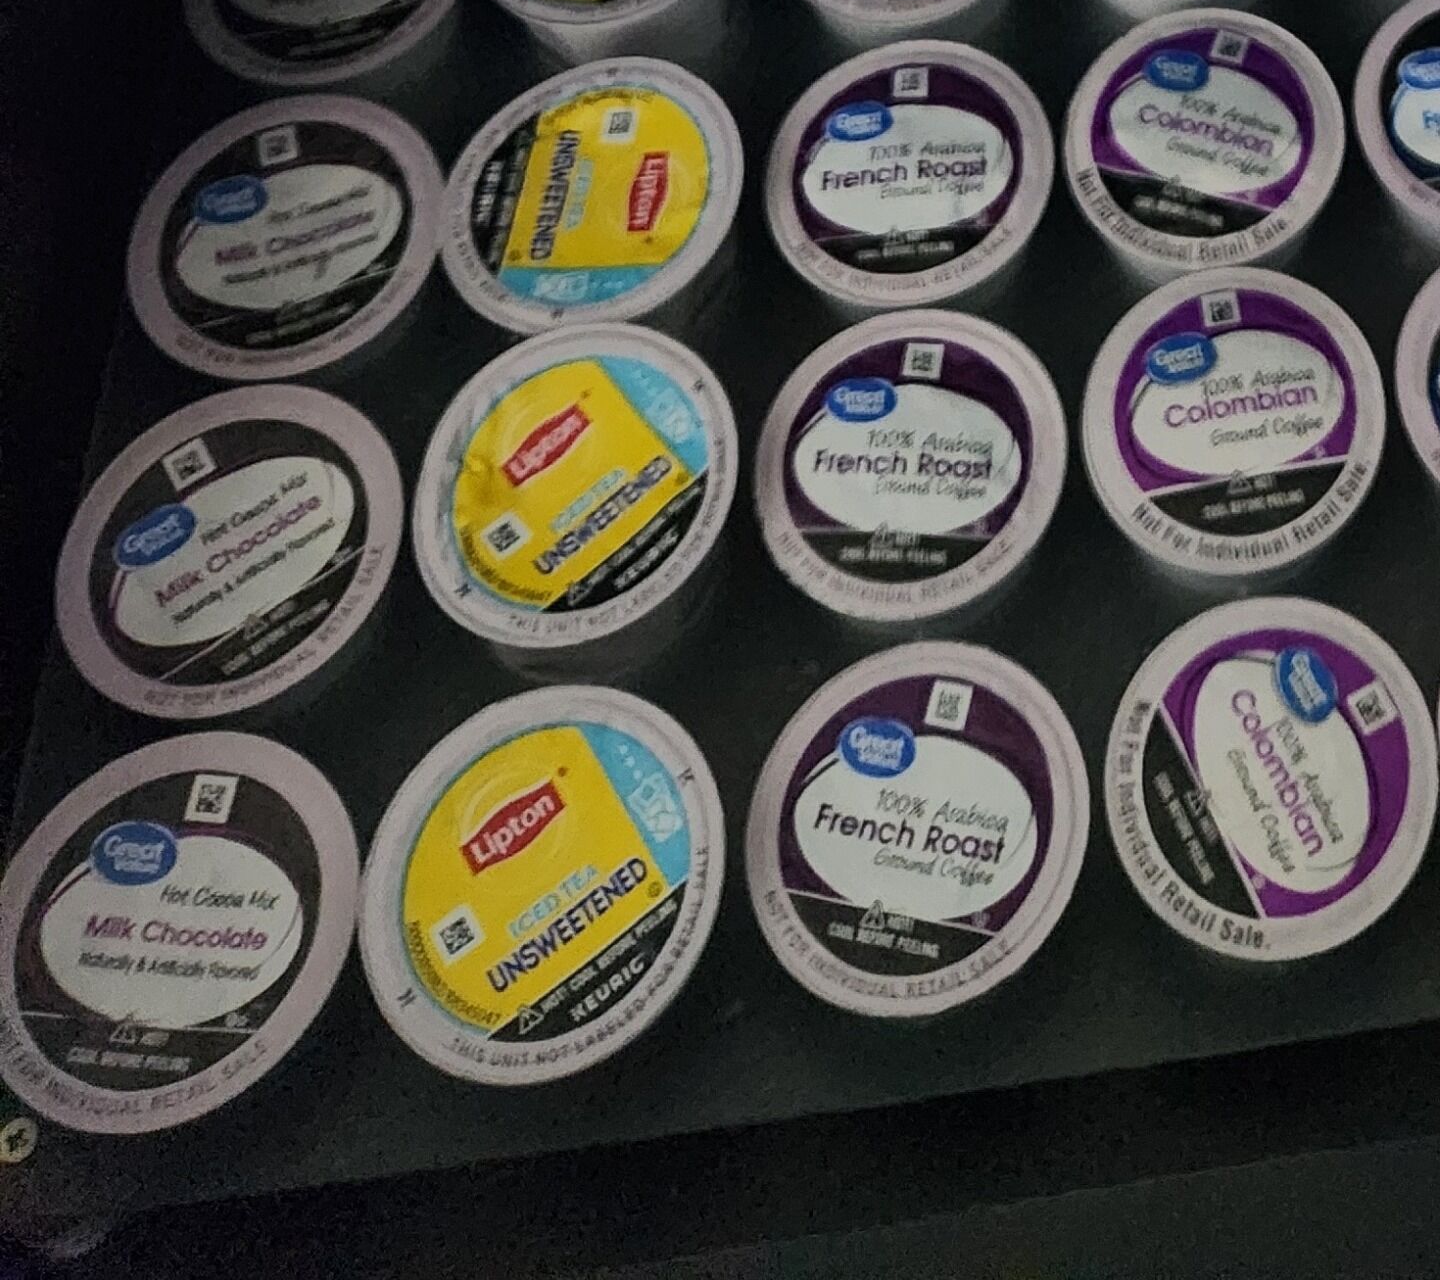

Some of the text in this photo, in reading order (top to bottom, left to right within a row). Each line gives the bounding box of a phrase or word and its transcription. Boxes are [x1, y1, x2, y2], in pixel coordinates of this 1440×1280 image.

[1137, 102, 1274, 158] Colombian
[528, 129, 581, 261] UNSWEETENED
[821, 157, 988, 191] French Roast
[1163, 383, 1319, 429] Colombian
[812, 448, 994, 480] French Roast
[533, 454, 673, 576] UNSWEETENED
[154, 494, 322, 609] Milk Chocolate
[1230, 687, 1325, 860] Colombian
[469, 792, 557, 865] Lipton
[813, 802, 1007, 865] French Roast
[875, 787, 1009, 833] 100% Arabica
[872, 848, 997, 889] Ground Coffee
[160, 882, 281, 912] Hot Cocoa Mix
[484, 856, 649, 994] UNSWEETENED
[508, 862, 600, 939] ICED TEA
[1162, 880, 1218, 933] Retail
[83, 914, 270, 951] Milk Chocolate
